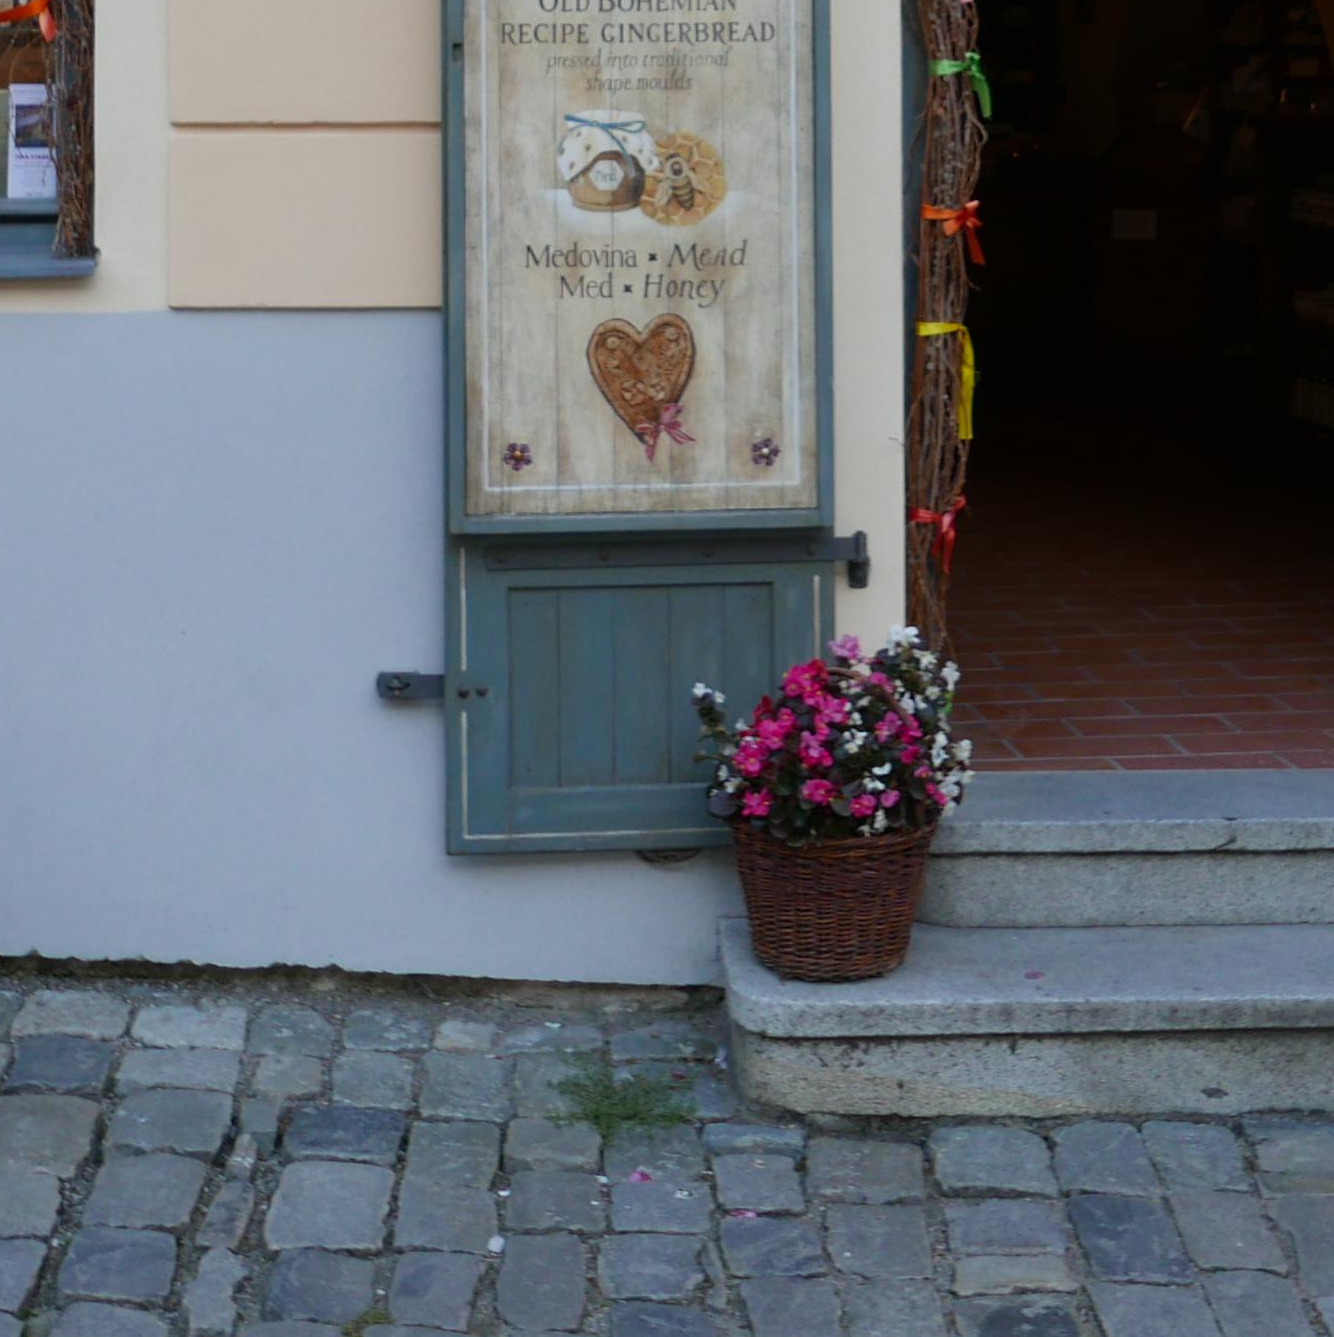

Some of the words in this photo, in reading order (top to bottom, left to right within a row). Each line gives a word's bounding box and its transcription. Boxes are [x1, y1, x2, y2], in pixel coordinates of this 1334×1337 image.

[501, 21, 591, 45] RECIPE
[601, 20, 776, 45] GINGERBREAD
[545, 47, 602, 75] pressed
[585, 70, 632, 94] shape
[636, 67, 694, 91] moulds
[525, 242, 638, 269] Medovina
[667, 240, 746, 270] Mead
[559, 274, 613, 300] Med
[643, 273, 727, 308] Honey
